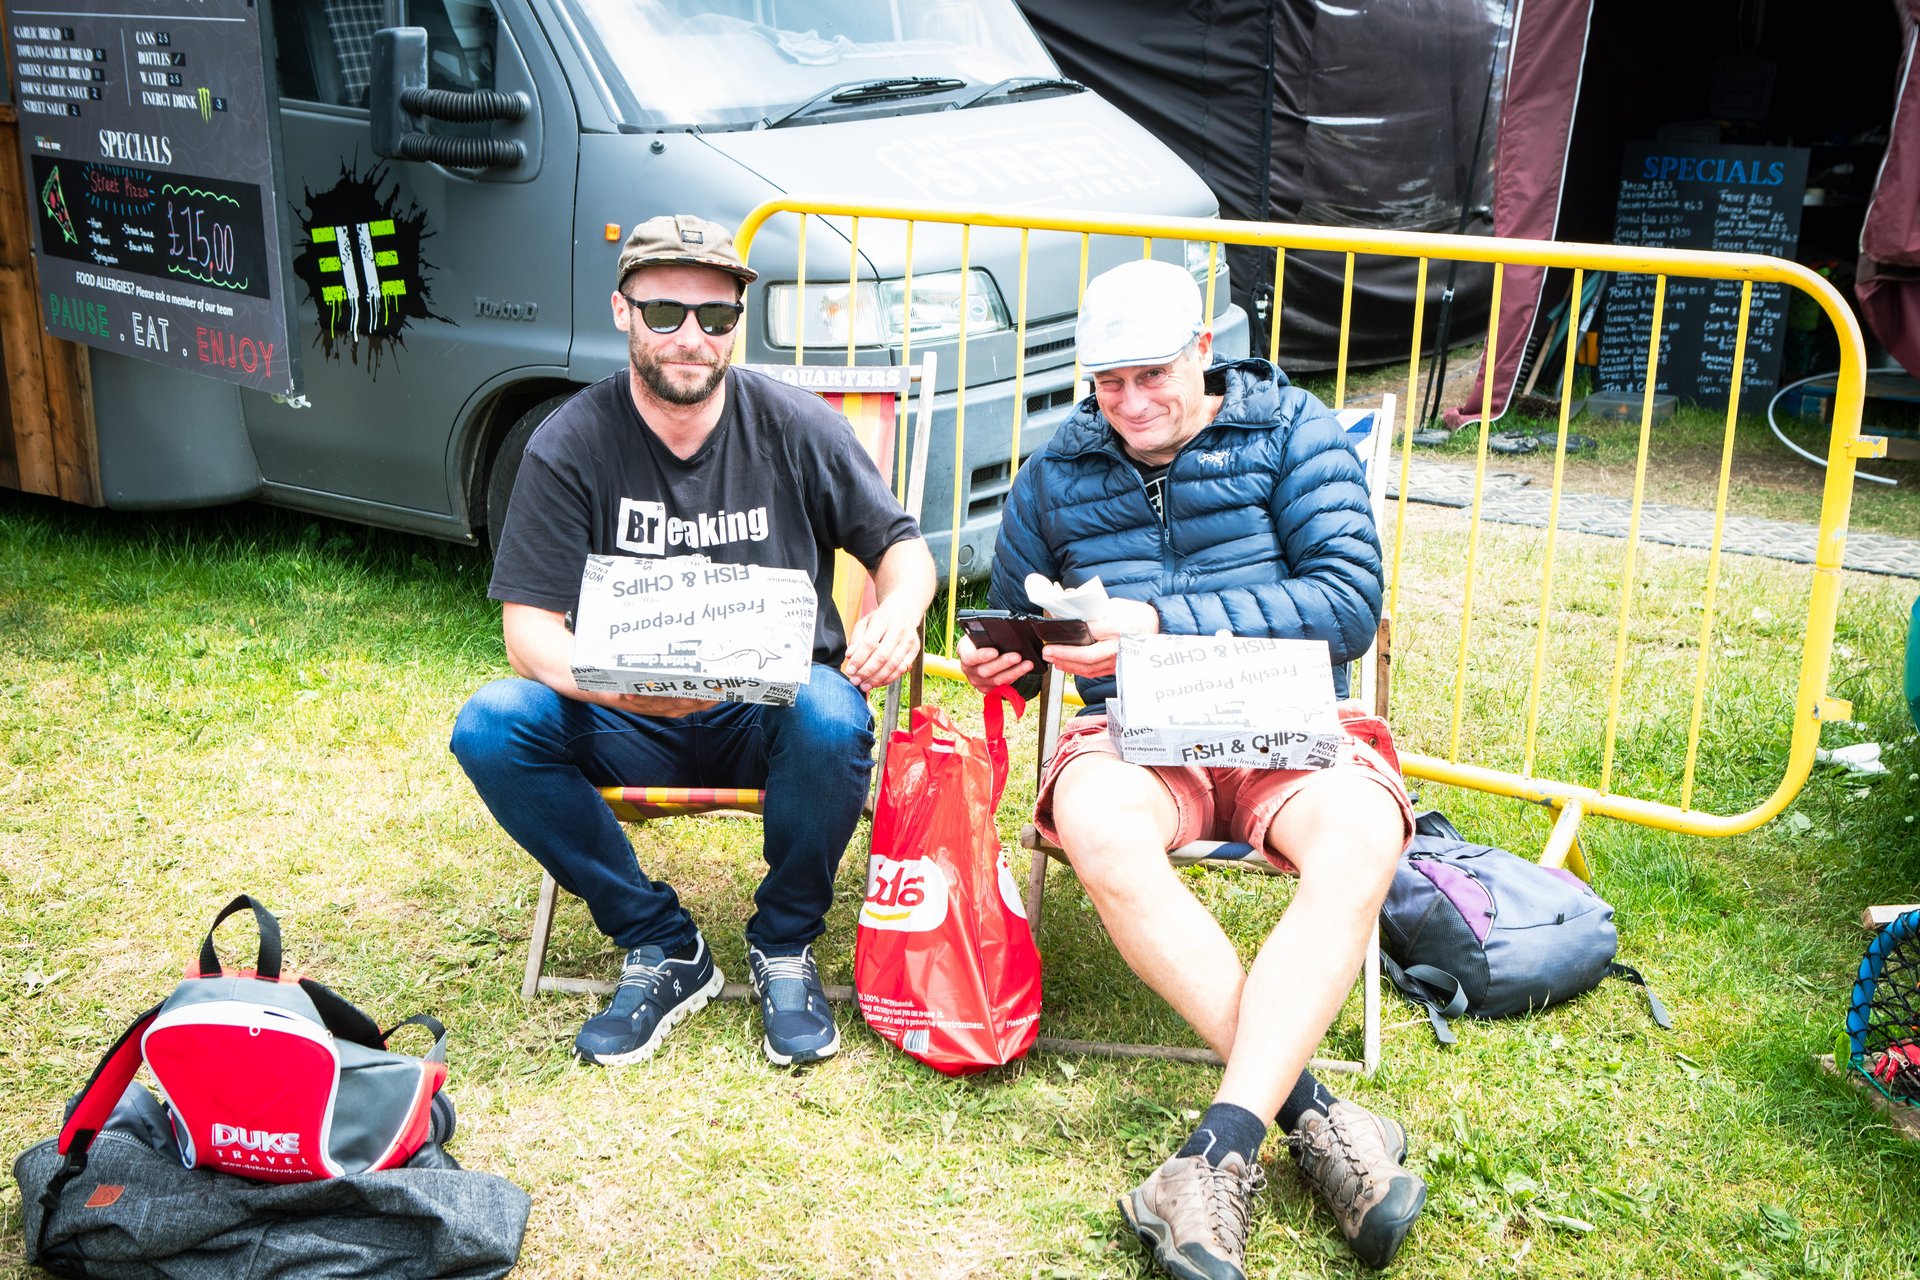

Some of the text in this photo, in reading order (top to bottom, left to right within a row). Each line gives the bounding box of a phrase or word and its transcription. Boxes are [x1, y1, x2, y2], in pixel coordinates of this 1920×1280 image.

[37, 26, 61, 41] BREAD
[135, 31, 156, 45] CANS
[69, 48, 93, 62] BREAD
[137, 51, 171, 67] BOTTLES
[67, 66, 92, 81] BREAD
[139, 71, 168, 86] WATER
[66, 85, 89, 100] SAUCE
[142, 91, 223, 110] ENERGY DRINK 3
[46, 102, 68, 116] SAUCE
[99, 130, 172, 166] SPECIALS
[1642, 156, 1785, 186] SPECIALS
[90, 170, 149, 199] Street Pizza
[1620, 180, 1648, 190] BACON
[1619, 190, 1656, 199] SAUSAGE
[75, 270, 99, 288] FOOD
[96, 275, 135, 295] ALLERGIES?
[135, 285, 155, 301] Please
[155, 290, 166, 302] ask
[172, 296, 196, 311] member
[197, 301, 205, 314] of
[205, 304, 217, 314] our
[217, 305, 234, 319] team
[1609, 286, 1634, 299] PORK
[1606, 301, 1639, 312] CHICKEN
[50, 292, 274, 379] PAUSE EAT ENJOY
[782, 368, 900, 388] QUARTERS
[626, 506, 769, 549] Breaking
[681, 571, 697, 588] &
[704, 564, 751, 585] FISH
[612, 574, 674, 598] CHIPS
[609, 598, 766, 640] Freshly Prepared
[1149, 638, 1278, 668] FISH & CHIPS
[633, 681, 678, 693] FISH
[683, 680, 699, 691] &
[1153, 664, 1299, 704] Freshly Prepared
[1181, 742, 1225, 763] FISH
[1230, 739, 1246, 754] &
[1252, 729, 1309, 750] CHIPS
[211, 1122, 300, 1154] DUKE
[215, 1149, 309, 1165] TRAVEL
